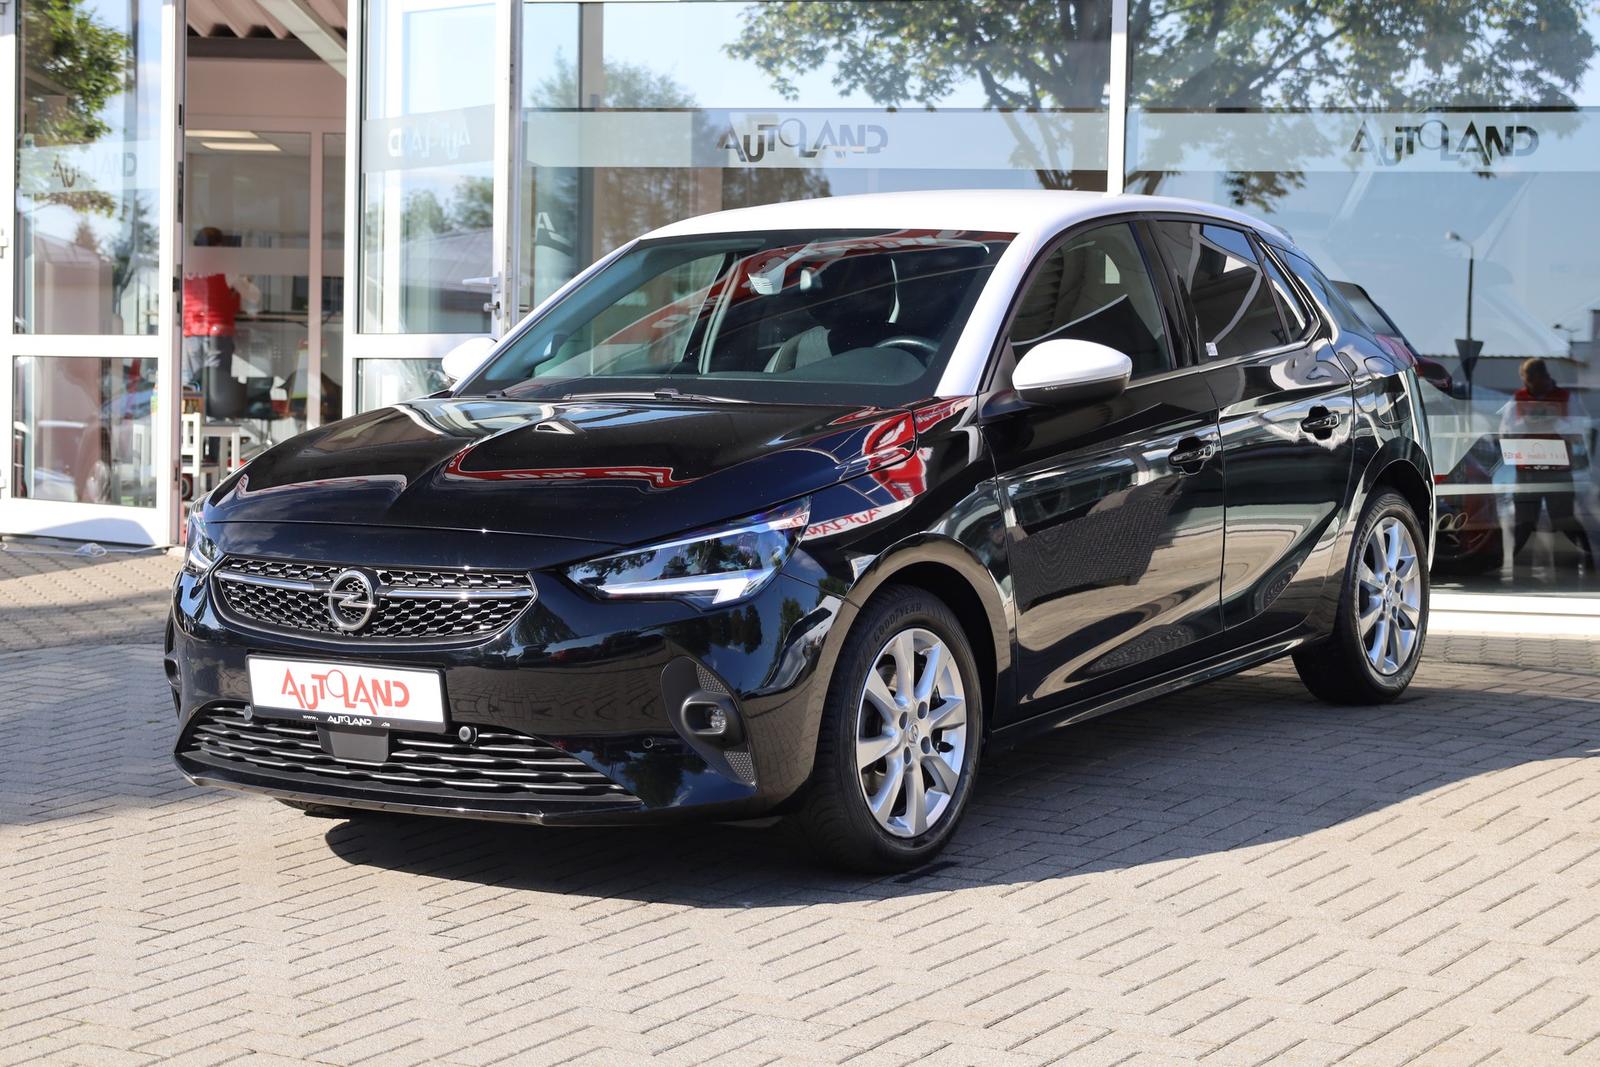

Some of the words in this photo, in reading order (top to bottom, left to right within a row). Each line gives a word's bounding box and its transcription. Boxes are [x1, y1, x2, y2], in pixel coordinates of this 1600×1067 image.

[717, 118, 889, 162] AUTOLAND
[1350, 119, 1540, 166] AUTOLAND
[281, 667, 410, 716] AUTOLAND
[327, 715, 373, 727] AUTOLAND
